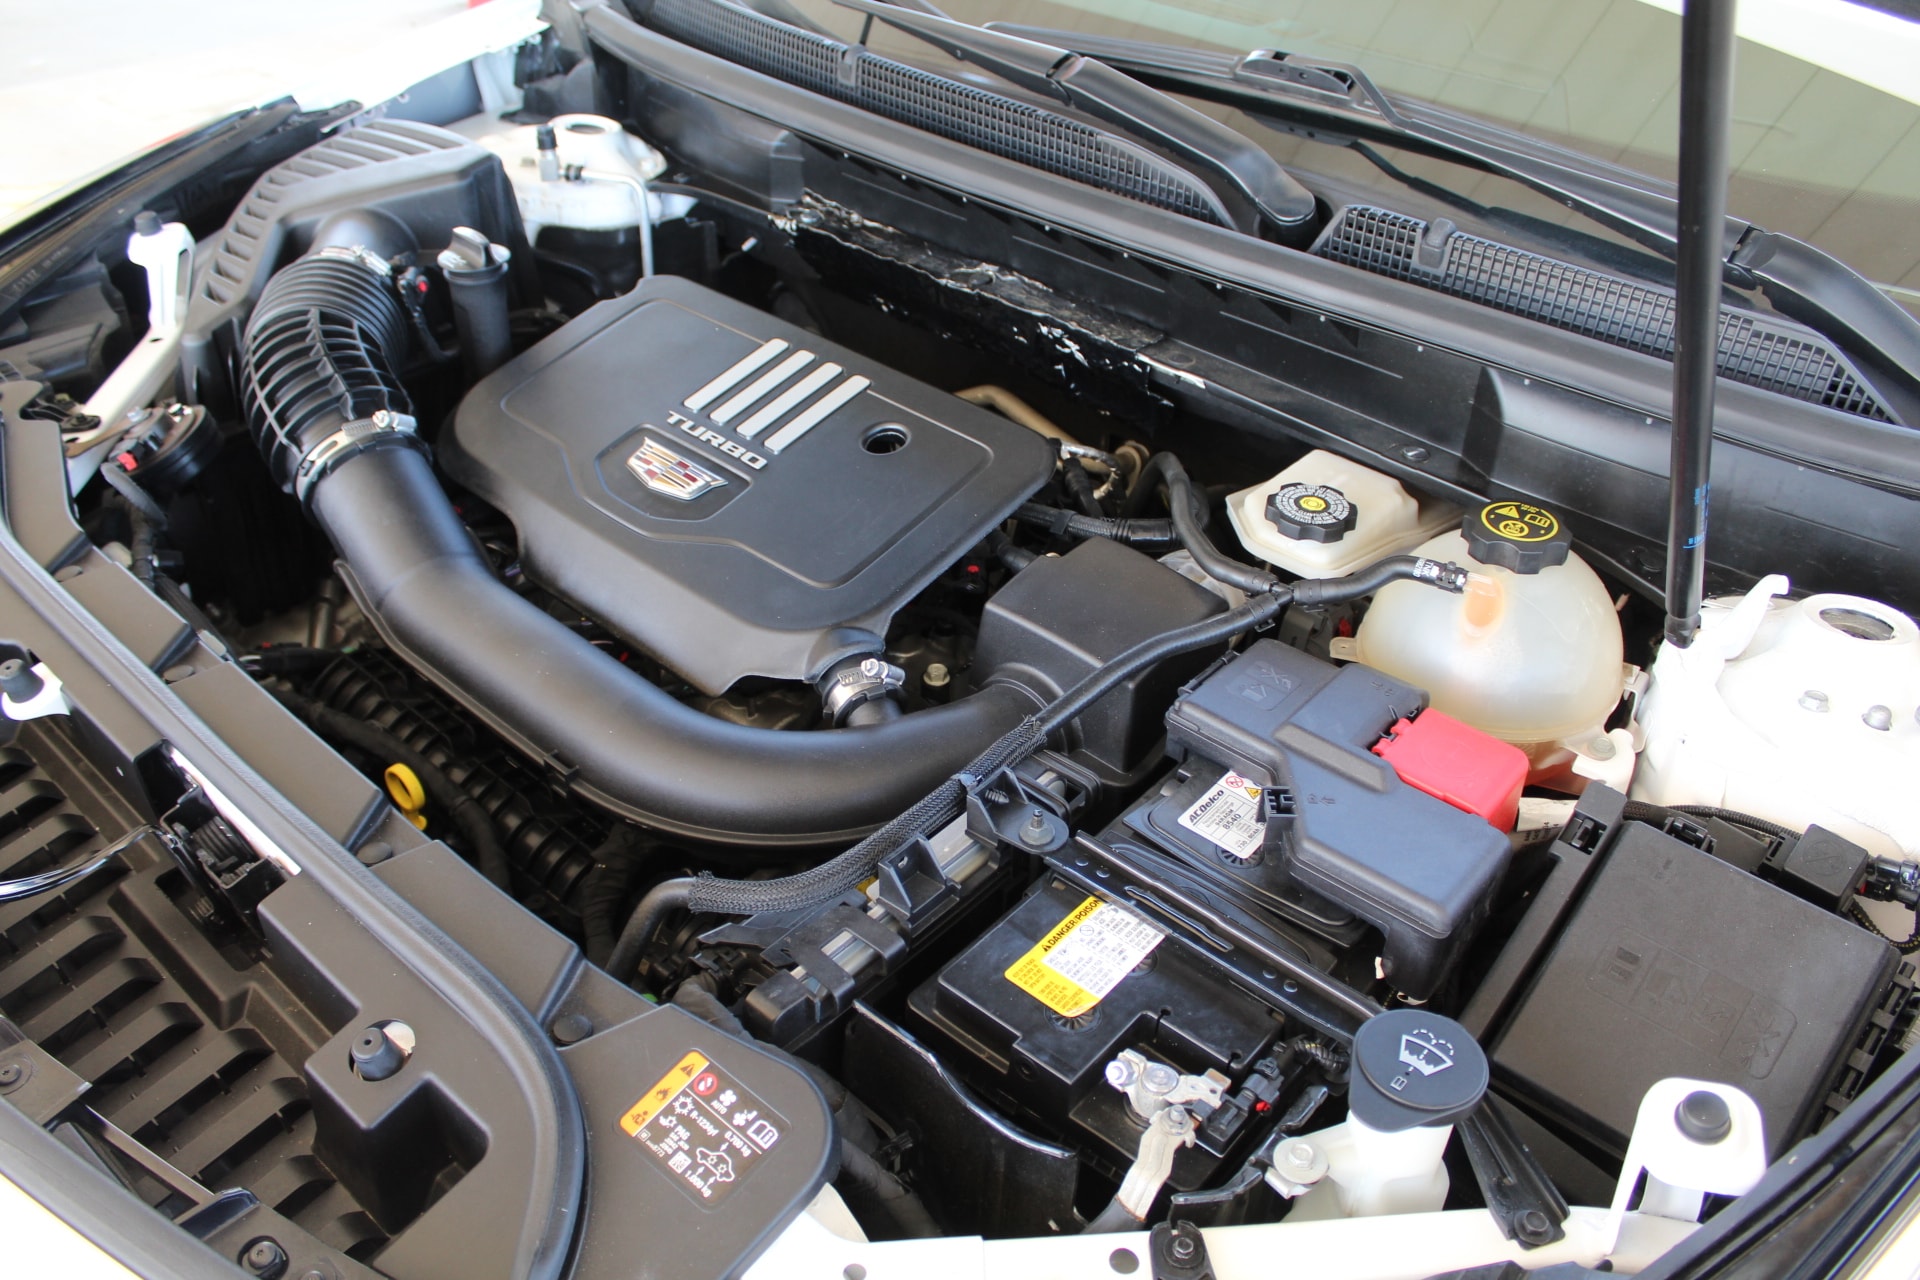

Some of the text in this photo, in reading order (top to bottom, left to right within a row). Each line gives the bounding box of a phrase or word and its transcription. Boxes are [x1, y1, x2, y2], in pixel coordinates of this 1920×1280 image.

[666, 410, 768, 470] TURBO
[1189, 789, 1225, 823] ACDelco
[1222, 813, 1242, 830] 8540
[710, 1101, 728, 1115] AUTO
[690, 1110, 719, 1137] R-1234yf
[674, 1124, 691, 1141] PAG
[738, 1144, 752, 1158] kg
[700, 1184, 713, 1198] kg
